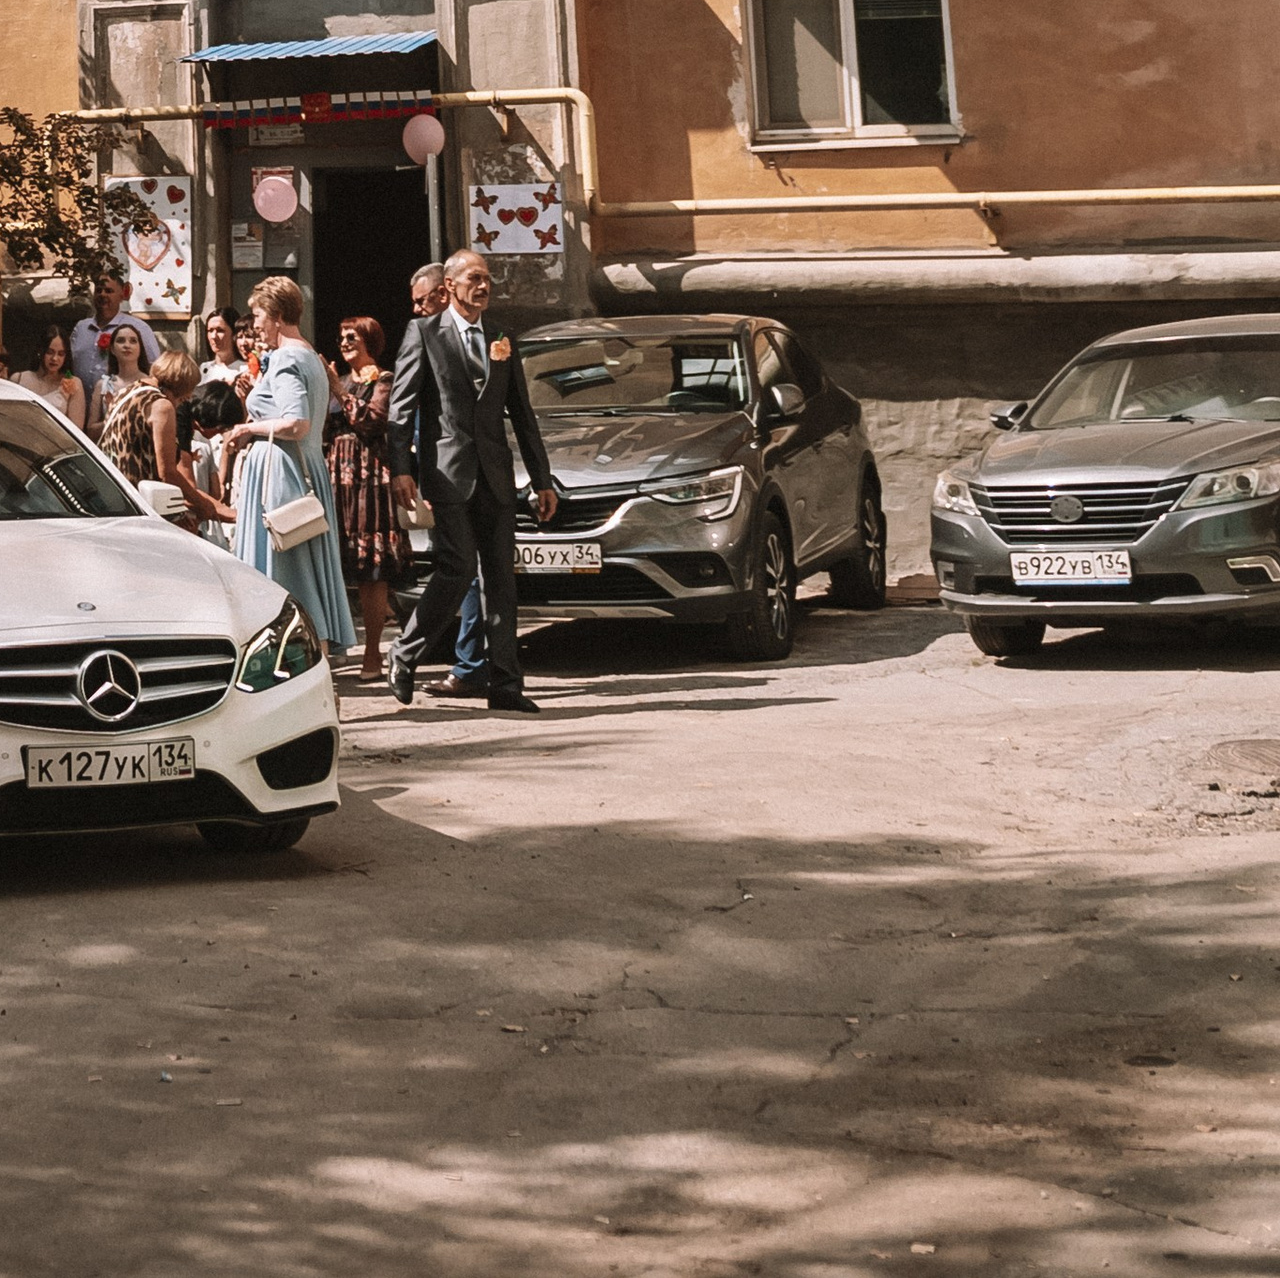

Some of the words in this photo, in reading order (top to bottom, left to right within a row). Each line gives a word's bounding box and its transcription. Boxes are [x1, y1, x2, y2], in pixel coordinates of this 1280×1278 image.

[575, 545, 594, 560] 34
[1095, 553, 1126, 569] 134
[38, 750, 146, 782] К127УК
[152, 742, 188, 768] 134
[160, 766, 178, 776] RUS
